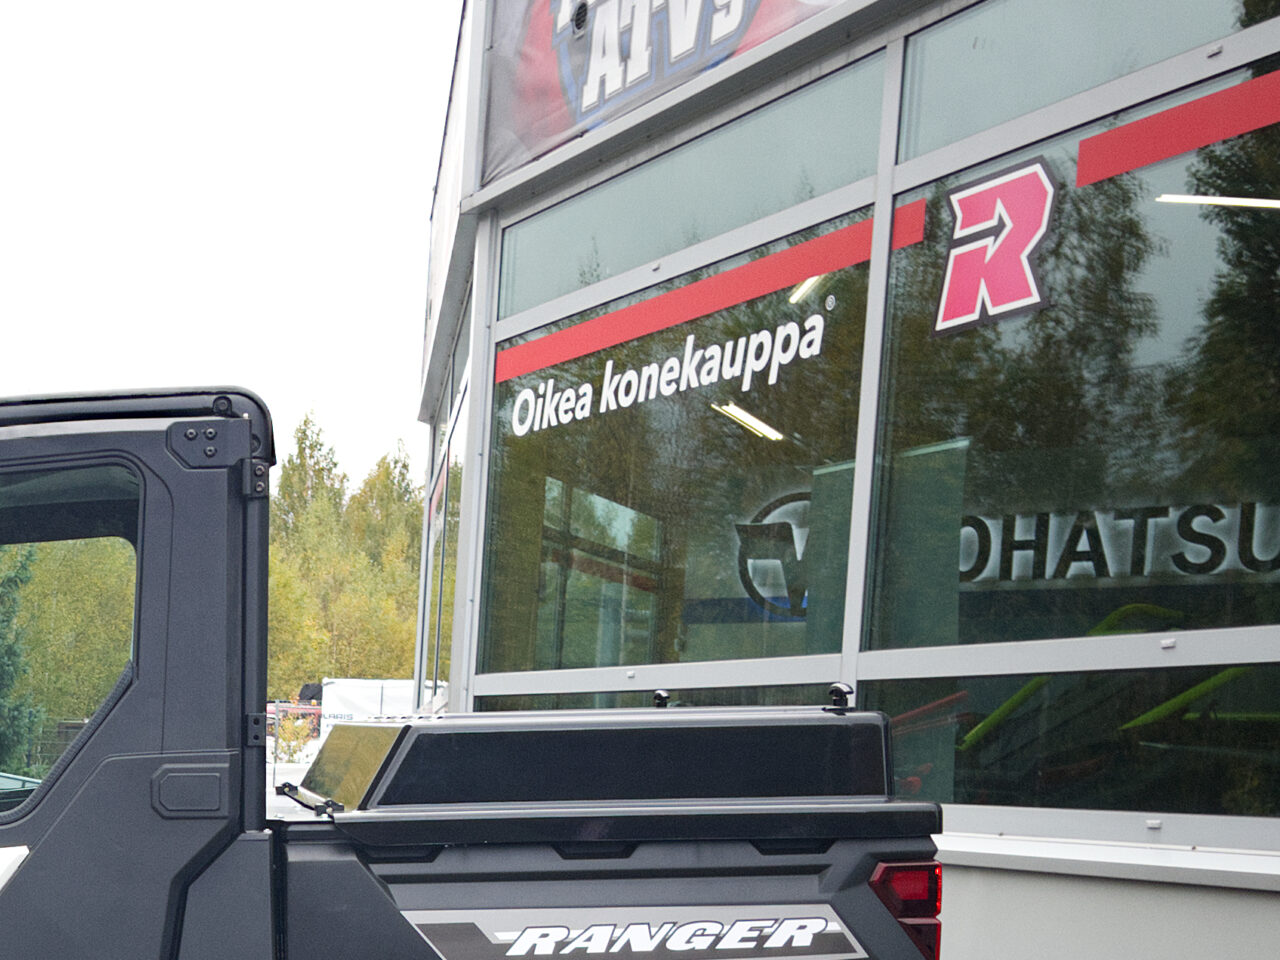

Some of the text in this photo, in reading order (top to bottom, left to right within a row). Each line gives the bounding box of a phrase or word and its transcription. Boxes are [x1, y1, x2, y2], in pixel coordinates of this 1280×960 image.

[511, 379, 593, 437] Oikea
[959, 502, 1280, 582] OHATSU
[505, 917, 830, 957] RANGER
